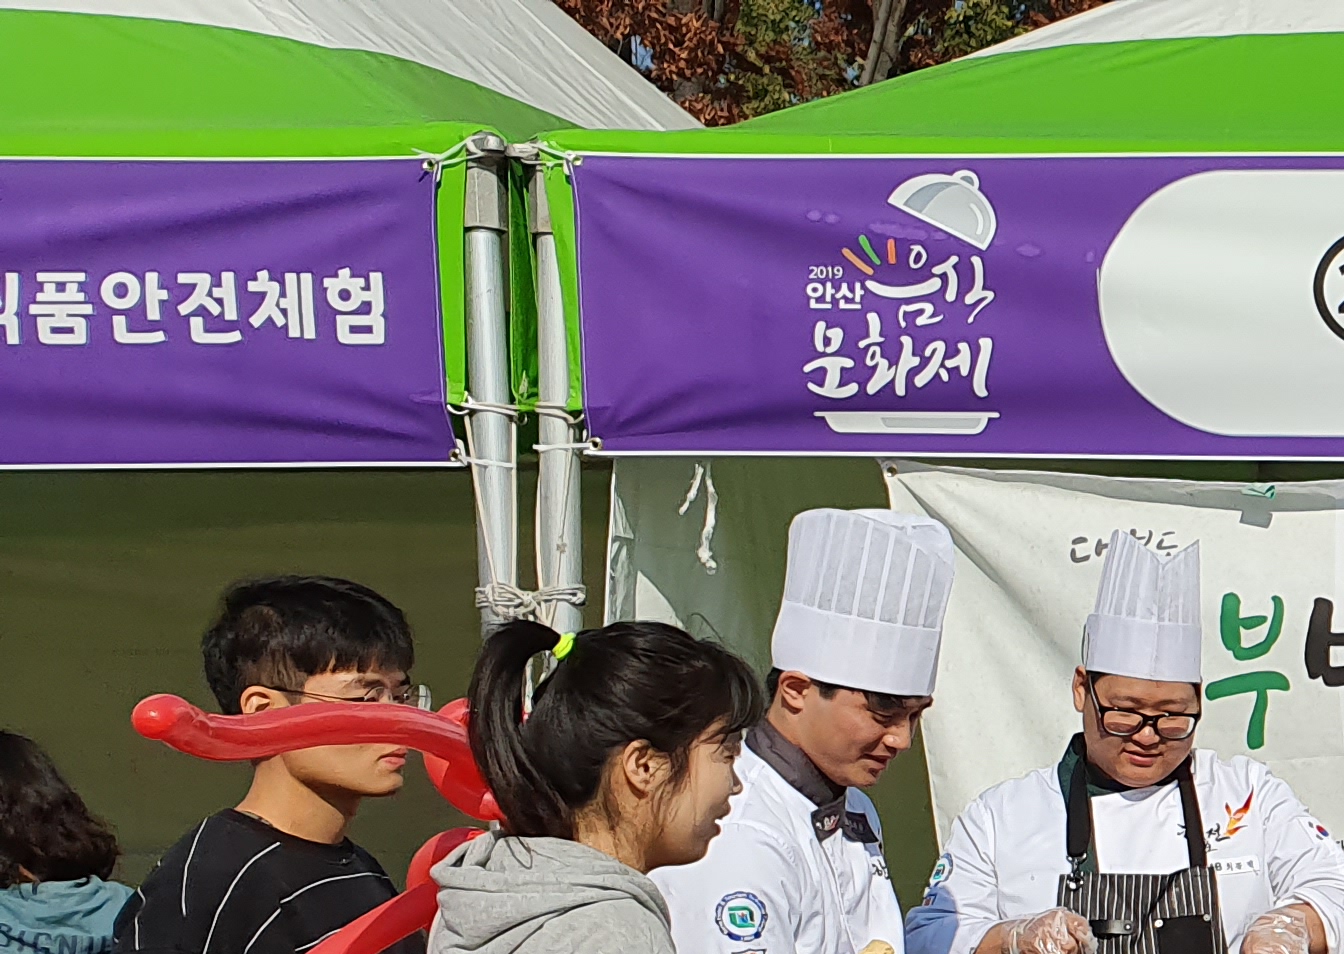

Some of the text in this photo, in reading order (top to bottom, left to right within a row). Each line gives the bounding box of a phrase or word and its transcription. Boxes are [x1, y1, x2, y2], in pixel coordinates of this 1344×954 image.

[808, 266, 843, 279] 2019
[806, 282, 864, 309] 안산
[803, 312, 993, 399] 문화제
